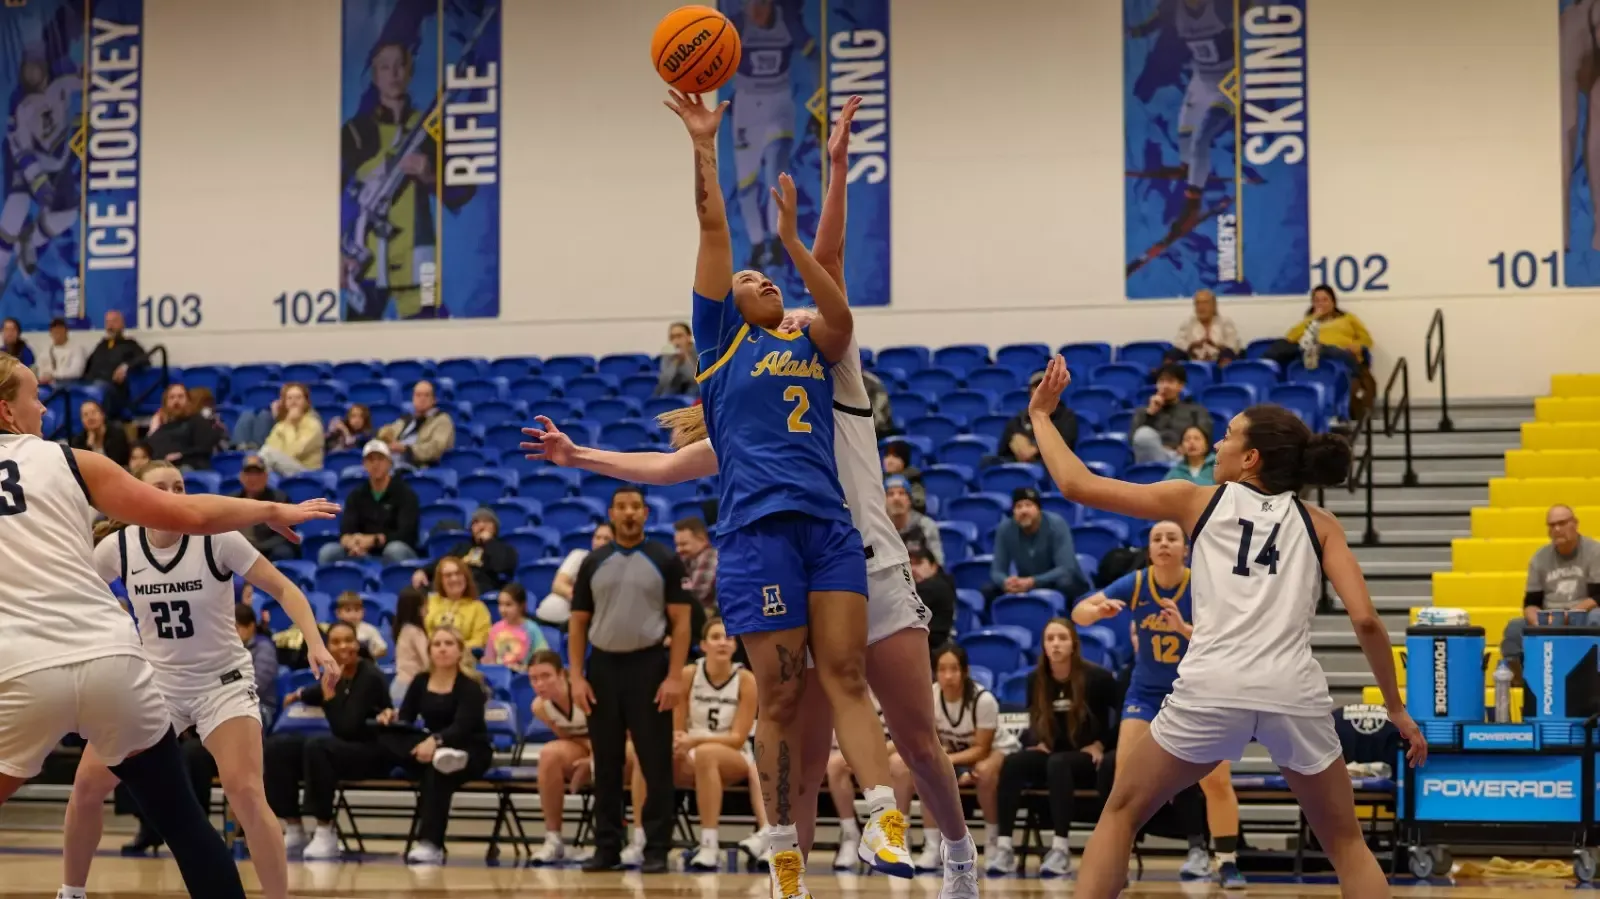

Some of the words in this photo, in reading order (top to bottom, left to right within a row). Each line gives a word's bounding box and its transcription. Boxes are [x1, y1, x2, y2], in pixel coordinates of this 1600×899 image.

[663, 28, 712, 73] Wilson
[88, 18, 139, 190] HOCKEY
[1244, 5, 1304, 165] SKIING
[444, 61, 497, 187] RIFLE
[829, 29, 887, 185] SKIING
[87, 200, 137, 270] ICE
[1217, 213, 1236, 282] WOMEN'S
[1310, 253, 1390, 293] 102
[1488, 250, 1559, 289] 101
[139, 293, 202, 329] 103
[273, 290, 338, 325] 102
[750, 350, 826, 381] Alask
[783, 385, 812, 434] 2
[1232, 517, 1281, 577] 14
[134, 579, 203, 596] MUSTANGS
[149, 599, 195, 640] 23
[1151, 634, 1180, 664] 12
[1434, 641, 1447, 714] POWERADE
[1543, 641, 1553, 716] POWERADE
[708, 707, 720, 731] 5
[1468, 731, 1534, 742] POWERADE
[1422, 778, 1574, 799] POWERADE
